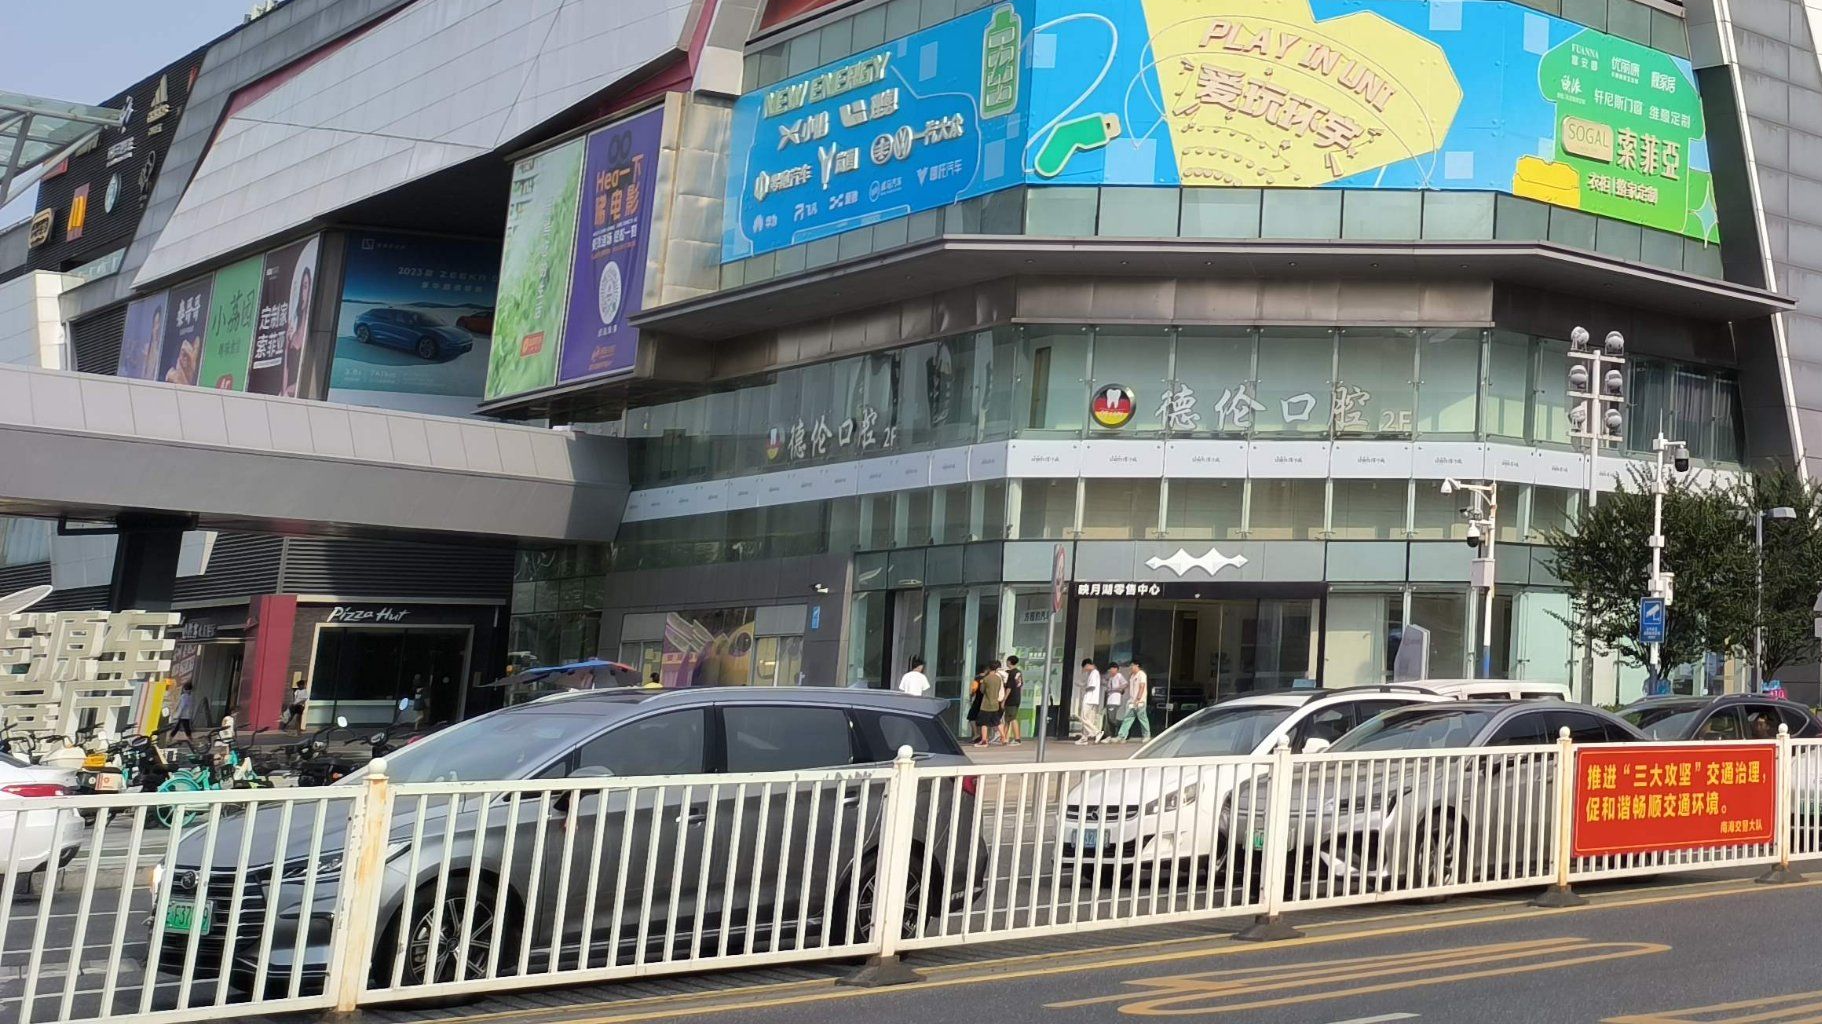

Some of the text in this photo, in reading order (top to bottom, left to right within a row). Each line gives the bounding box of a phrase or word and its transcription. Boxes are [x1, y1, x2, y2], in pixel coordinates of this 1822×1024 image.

[1199, 20, 1396, 113] PLAY IN UNI
[764, 51, 892, 118] NEW ENERGY
[1197, 63, 1364, 151] 爱玩环宇
[1568, 123, 1608, 148] SOGAL
[1155, 383, 1414, 432] 德伦口腔 2F
[883, 426, 897, 448] 2F
[1078, 583, 1161, 596] 映月湖零售中心
[327, 606, 412, 622] Pizza Hut
[1720, 819, 1763, 834] 南海交警大队
